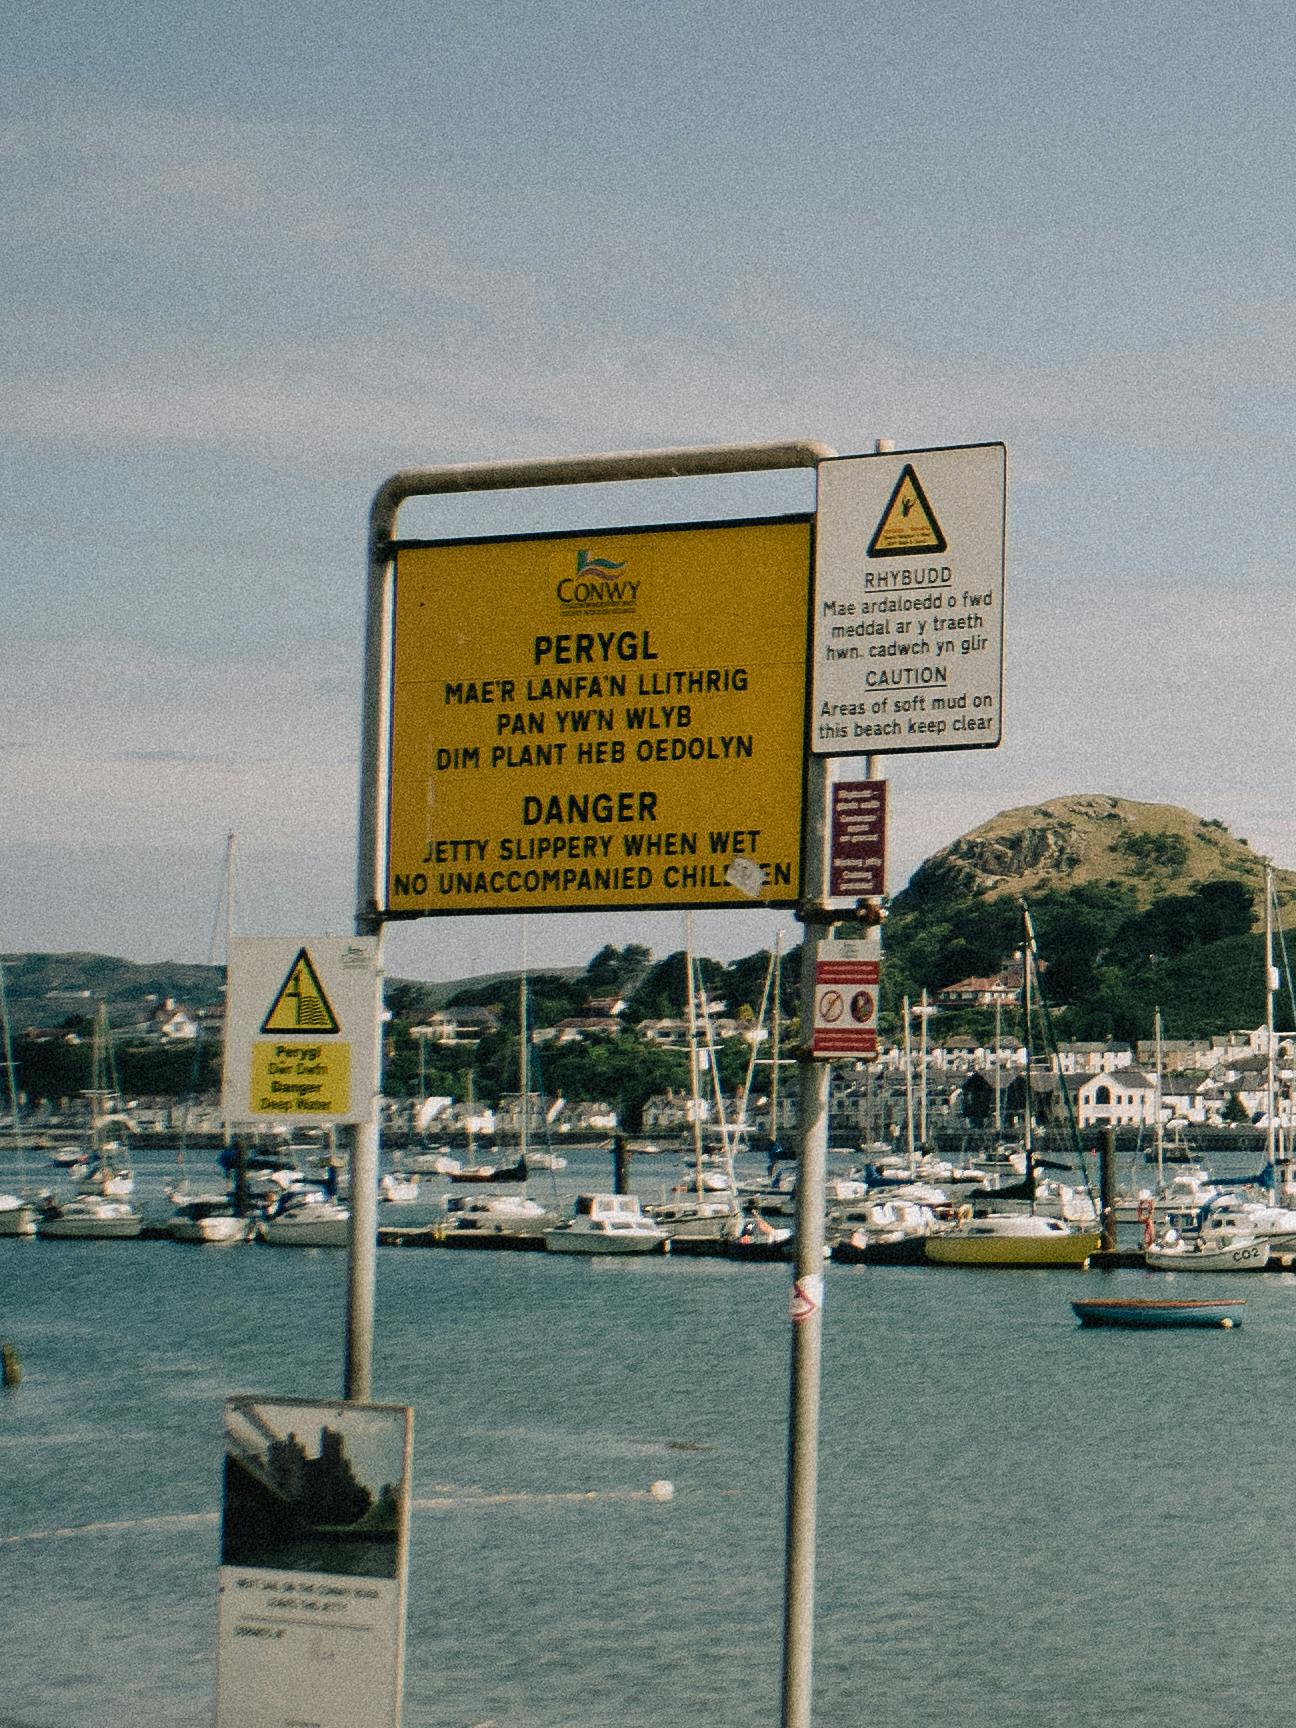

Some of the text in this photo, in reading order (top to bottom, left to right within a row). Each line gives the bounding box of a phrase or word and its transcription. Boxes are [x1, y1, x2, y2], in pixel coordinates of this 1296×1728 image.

[864, 566, 952, 589] RHYBUDD
[823, 590, 993, 617] Mae ardaloedd o fwd
[831, 612, 983, 638] meddal ar y traeth
[534, 630, 659, 665] PERYGL
[868, 638, 930, 658] cadwch
[936, 640, 955, 657] yn
[960, 634, 988, 655] glir
[444, 668, 748, 705] MAE'R LANFA'N LLITHRIG
[864, 665, 947, 687] CAUTION
[820, 692, 993, 717] Areas of soft mud on
[496, 704, 691, 736] PAN YW'N WLYB
[818, 715, 993, 740] this beach keep clear
[436, 735, 753, 770] DIM PLANT HEB OEDOLYN
[522, 791, 658, 826] DANGER
[422, 830, 761, 864] JETTY SLIPPERY WHEN WET
[394, 862, 791, 896] NO UNACCOMPANIED CHILEN
